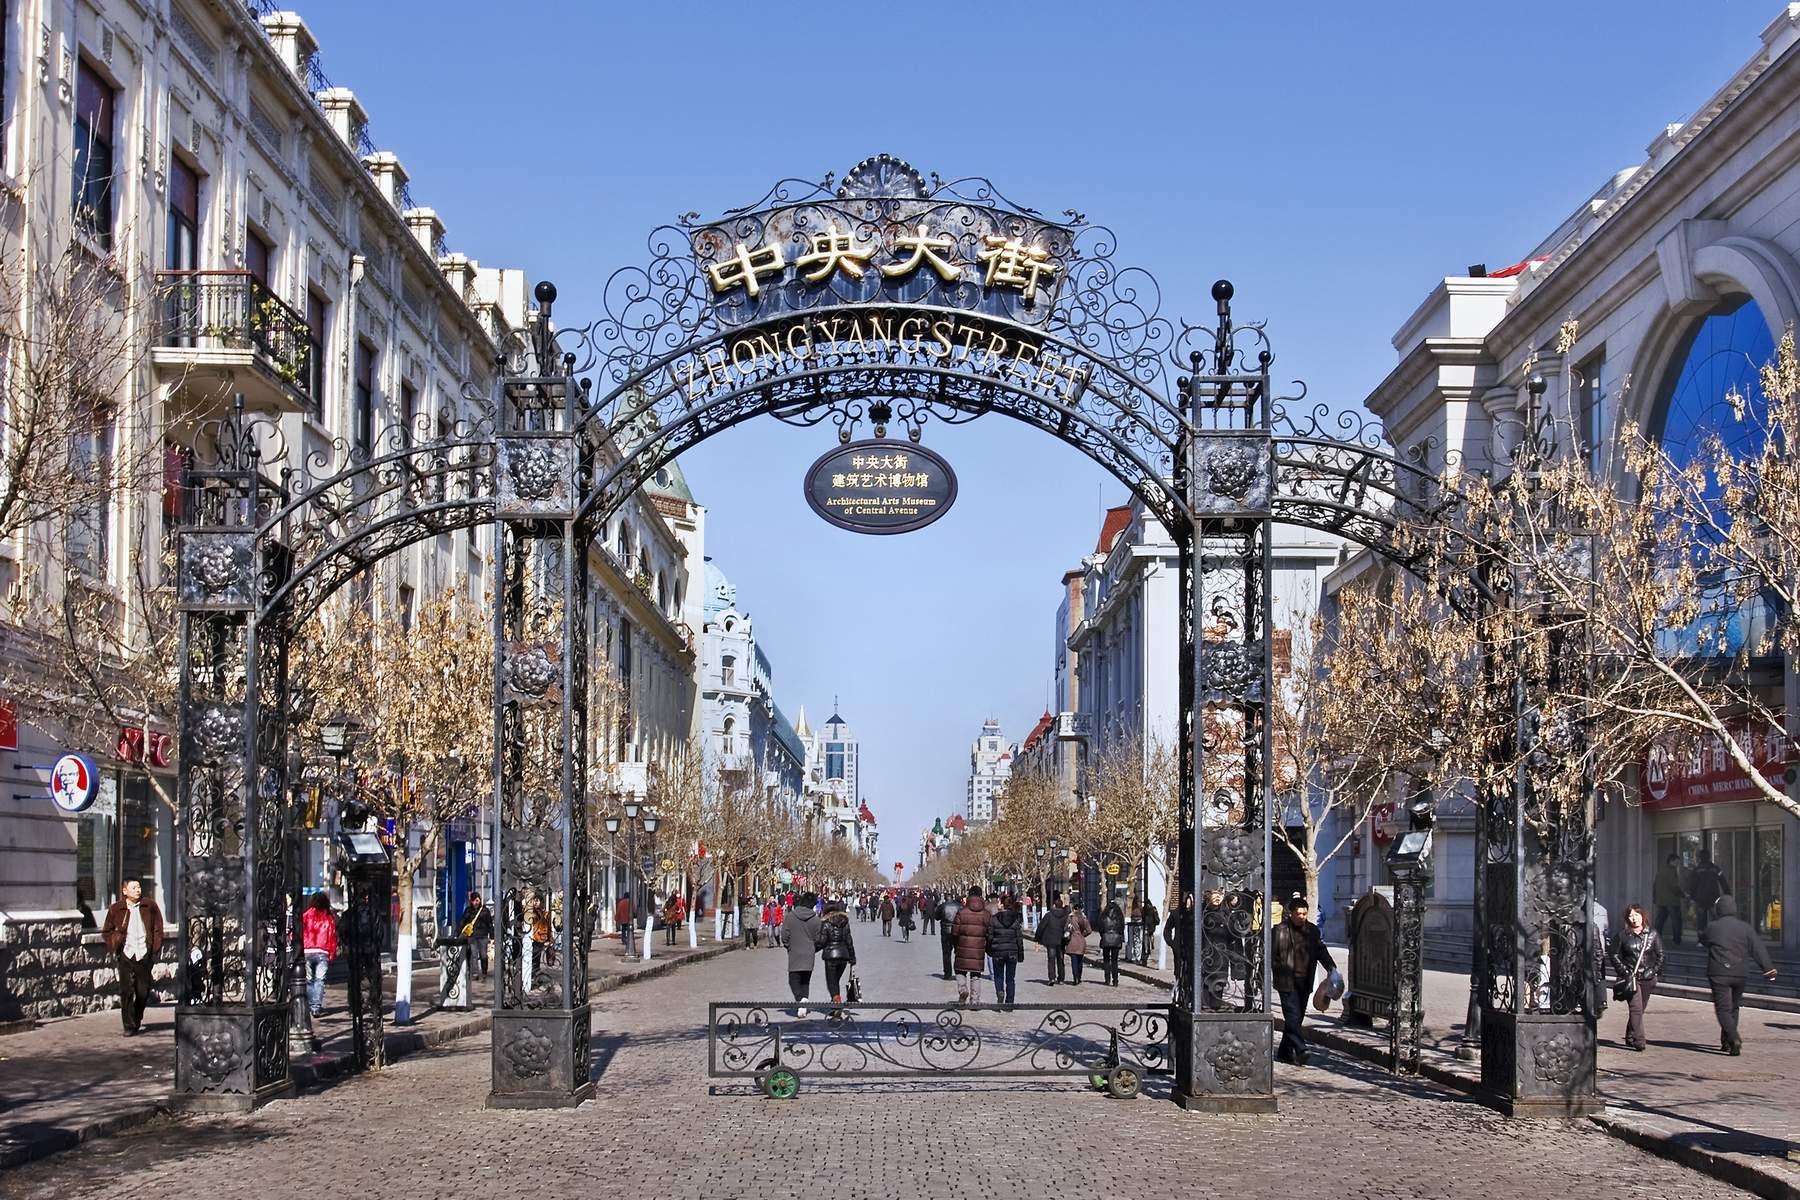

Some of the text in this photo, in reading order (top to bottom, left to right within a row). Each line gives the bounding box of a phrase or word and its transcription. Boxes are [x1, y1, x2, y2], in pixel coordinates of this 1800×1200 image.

[708, 225, 1060, 300] 中央大街
[852, 455, 908, 470] 中央大街
[832, 473, 929, 488] 建筑艺术博物馆
[826, 497, 936, 506] Architectural Arts Museum
[844, 506, 918, 515] of Central Avenue
